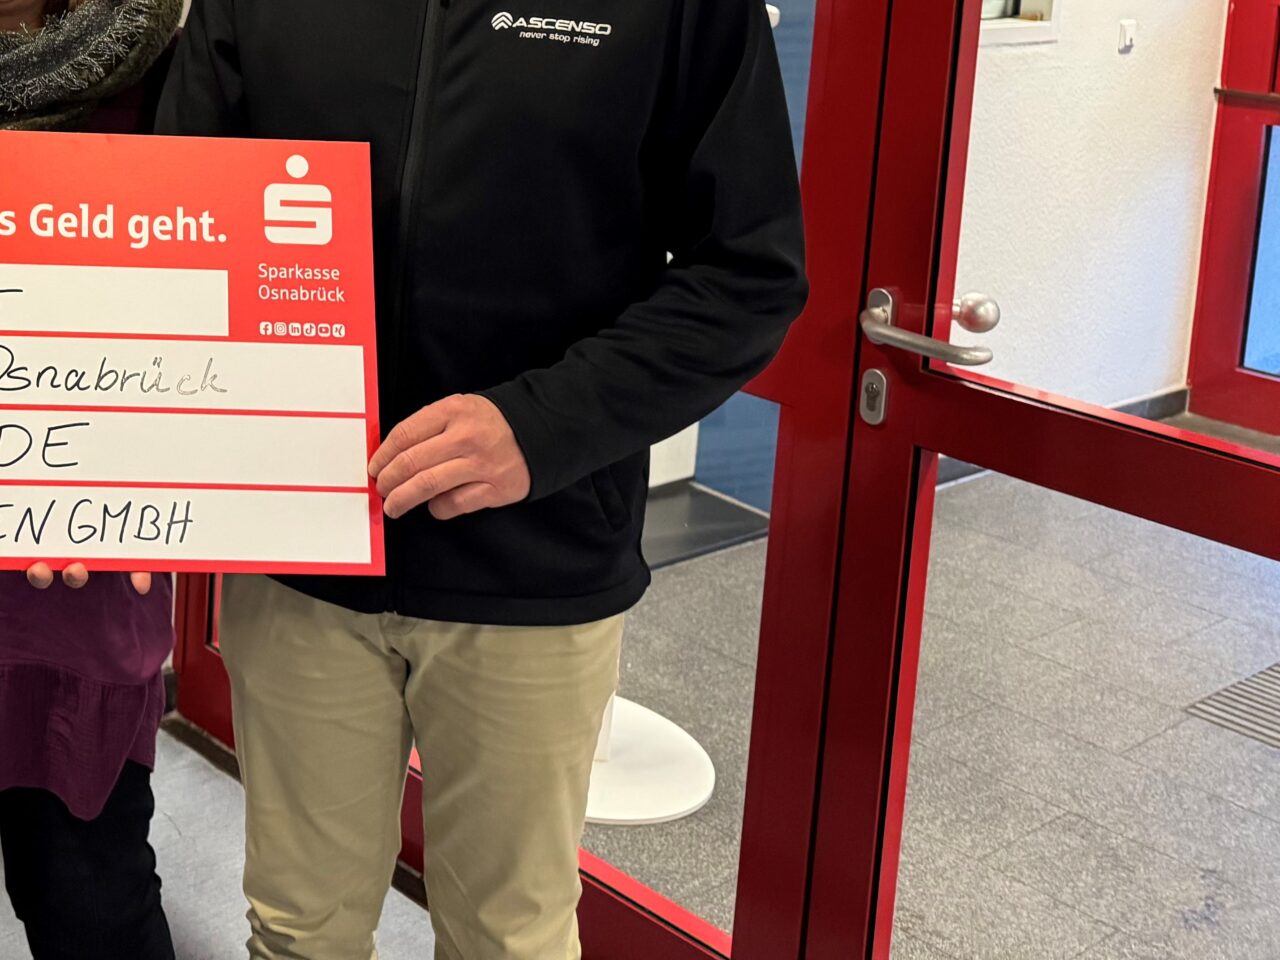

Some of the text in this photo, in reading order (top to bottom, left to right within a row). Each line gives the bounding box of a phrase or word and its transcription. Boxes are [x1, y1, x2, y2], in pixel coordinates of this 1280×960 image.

[512, 17, 611, 35] ASCENSO
[519, 31, 600, 46] never stop rising
[29, 202, 115, 239] Geld
[128, 207, 228, 248] geht.
[258, 263, 340, 281] Sparkasse
[258, 285, 345, 302] Osnabrück
[68, 499, 194, 545] GMBH
